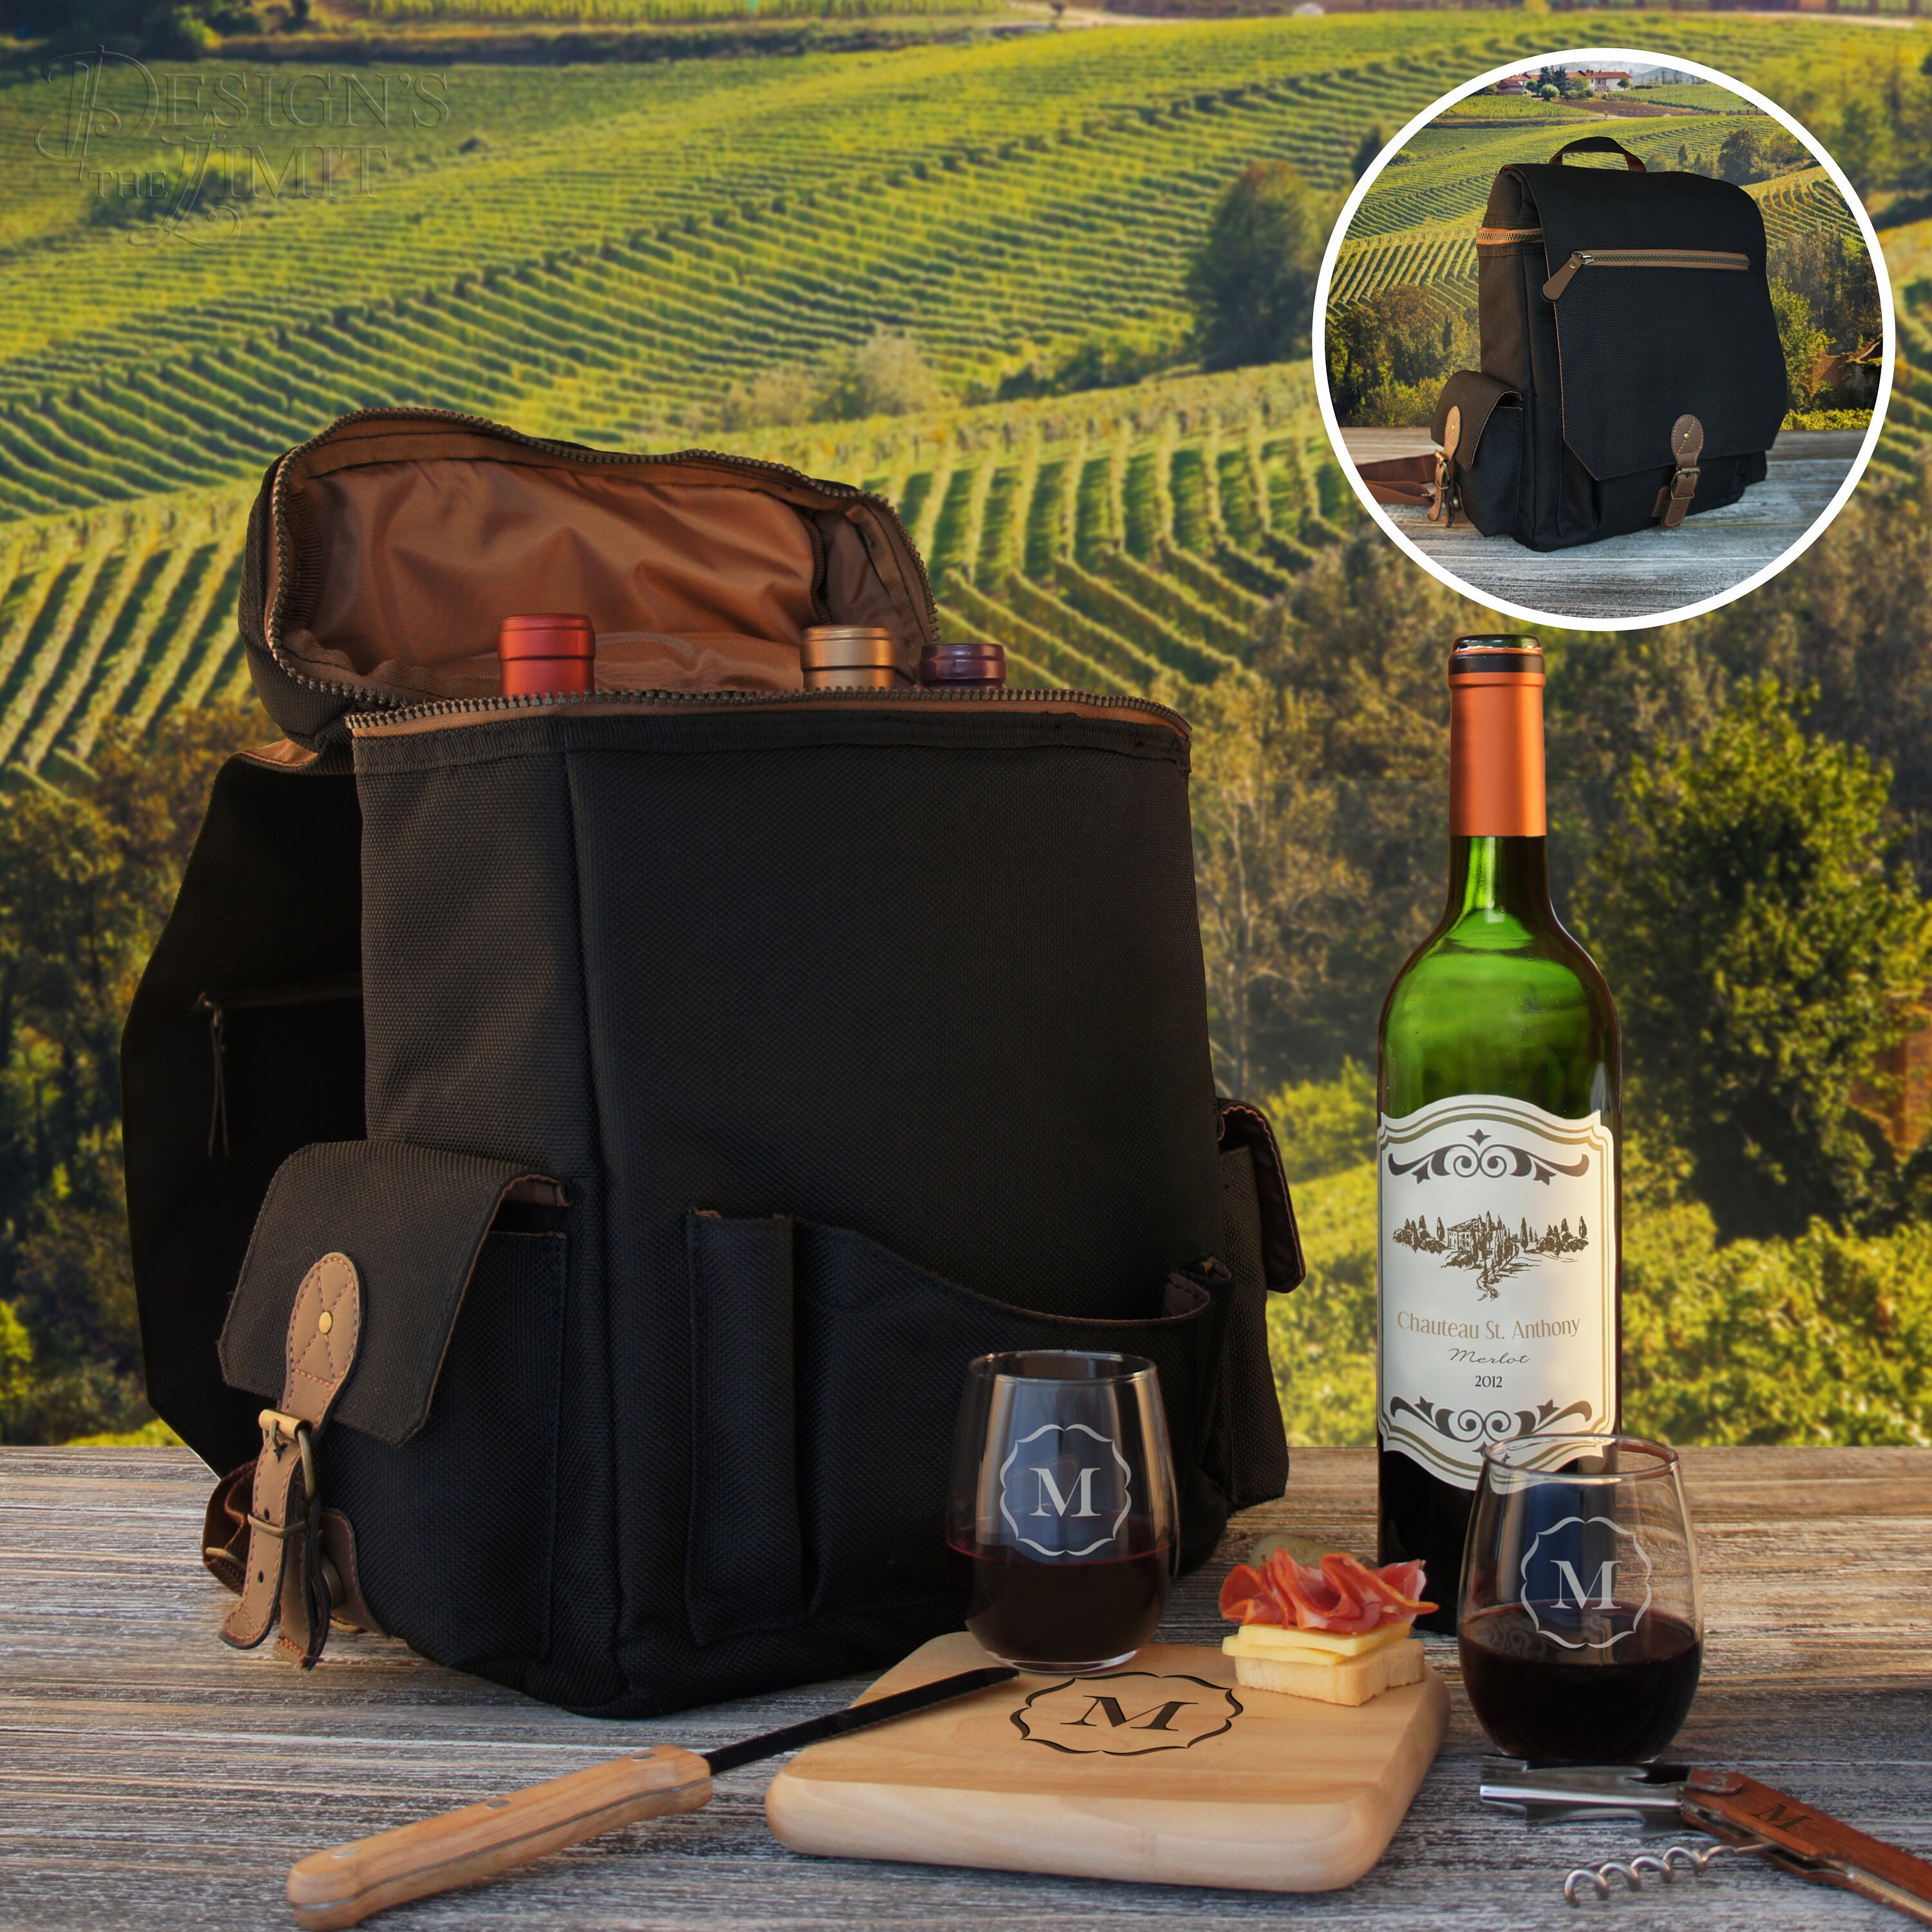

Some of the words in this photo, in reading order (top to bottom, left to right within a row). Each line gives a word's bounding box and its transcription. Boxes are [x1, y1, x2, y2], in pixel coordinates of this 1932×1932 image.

[1397, 1311, 1479, 1340] Chauteau
[1486, 1319, 1505, 1340] St.
[1511, 1316, 1580, 1340] Anthony
[1448, 1348, 1531, 1365] Merlot
[1474, 1375, 1503, 1388] 2012
[1029, 1467, 1101, 1518] M
[1549, 1559, 1622, 1610] M
[1060, 1695, 1199, 1732] M
[1750, 1802, 1813, 1833] M
